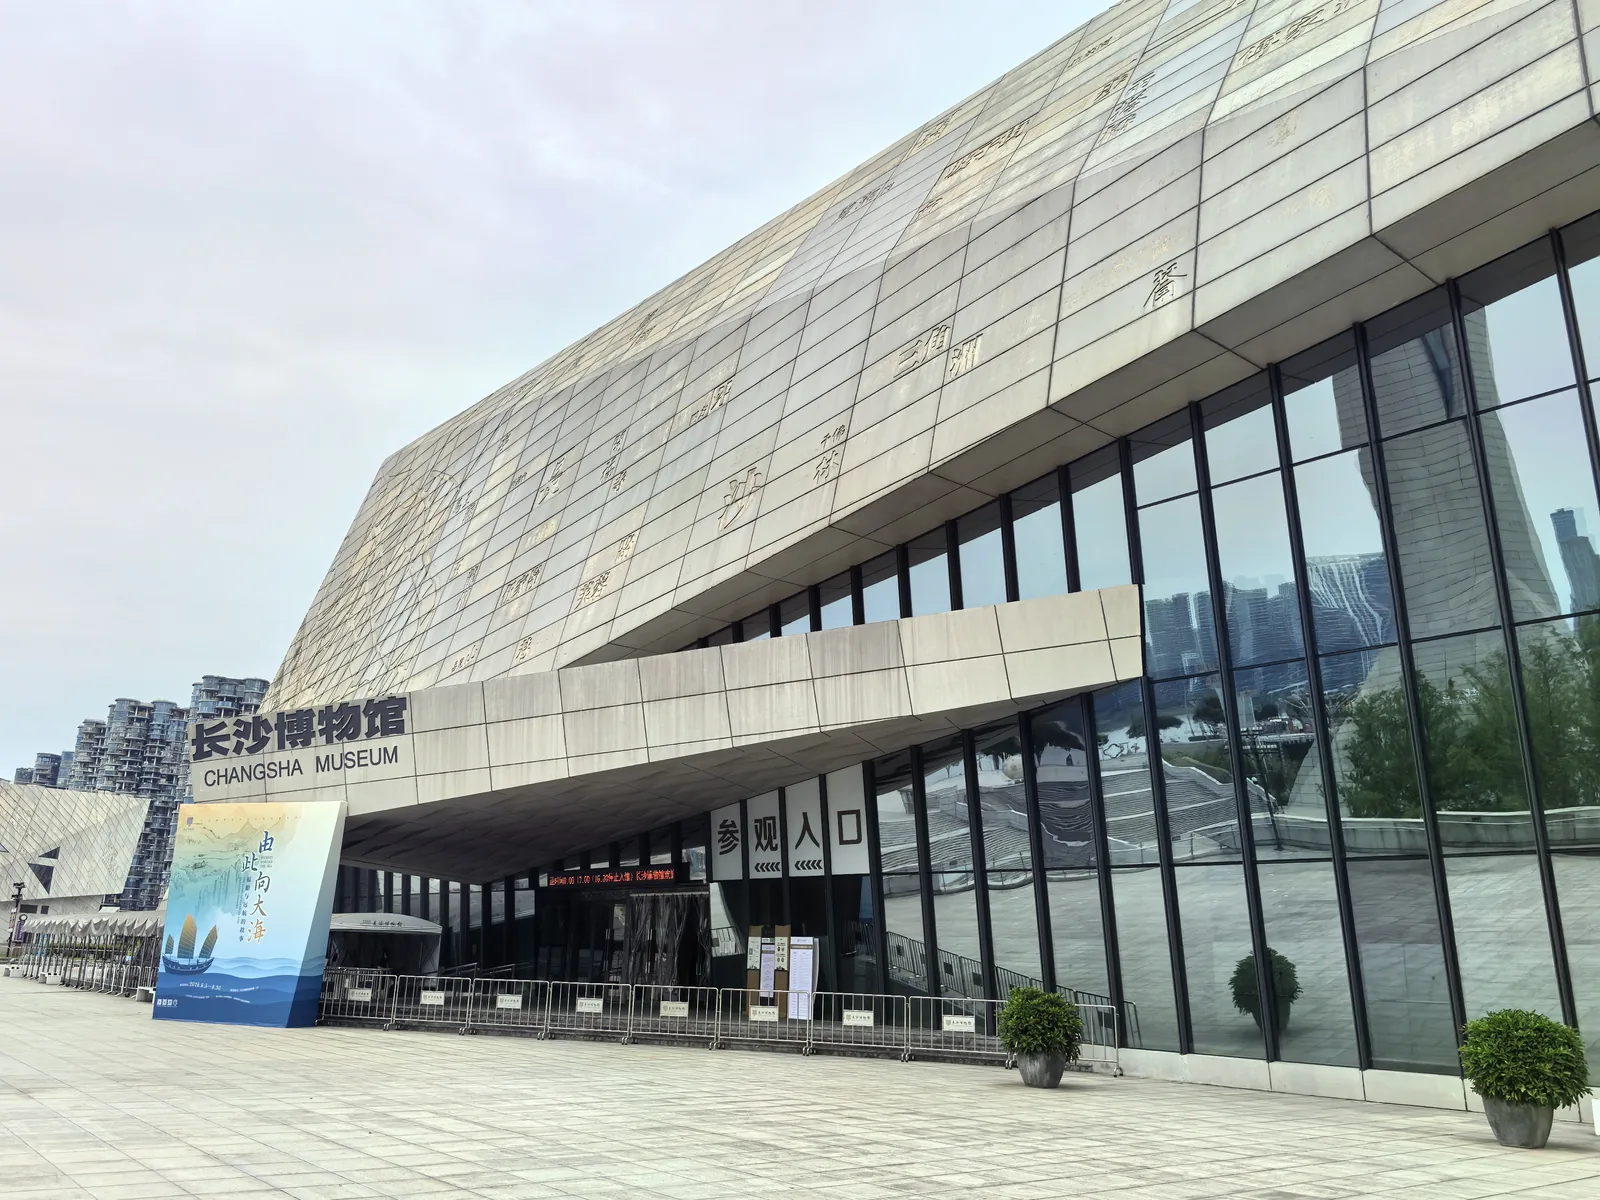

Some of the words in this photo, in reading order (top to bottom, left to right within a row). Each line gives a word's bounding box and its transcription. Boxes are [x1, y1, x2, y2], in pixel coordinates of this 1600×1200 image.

[192, 696, 407, 761] 长沙博物馆
[204, 758, 303, 787] CHANGSHA
[316, 746, 398, 773] MUSEUM
[718, 809, 862, 855] 参观入口
